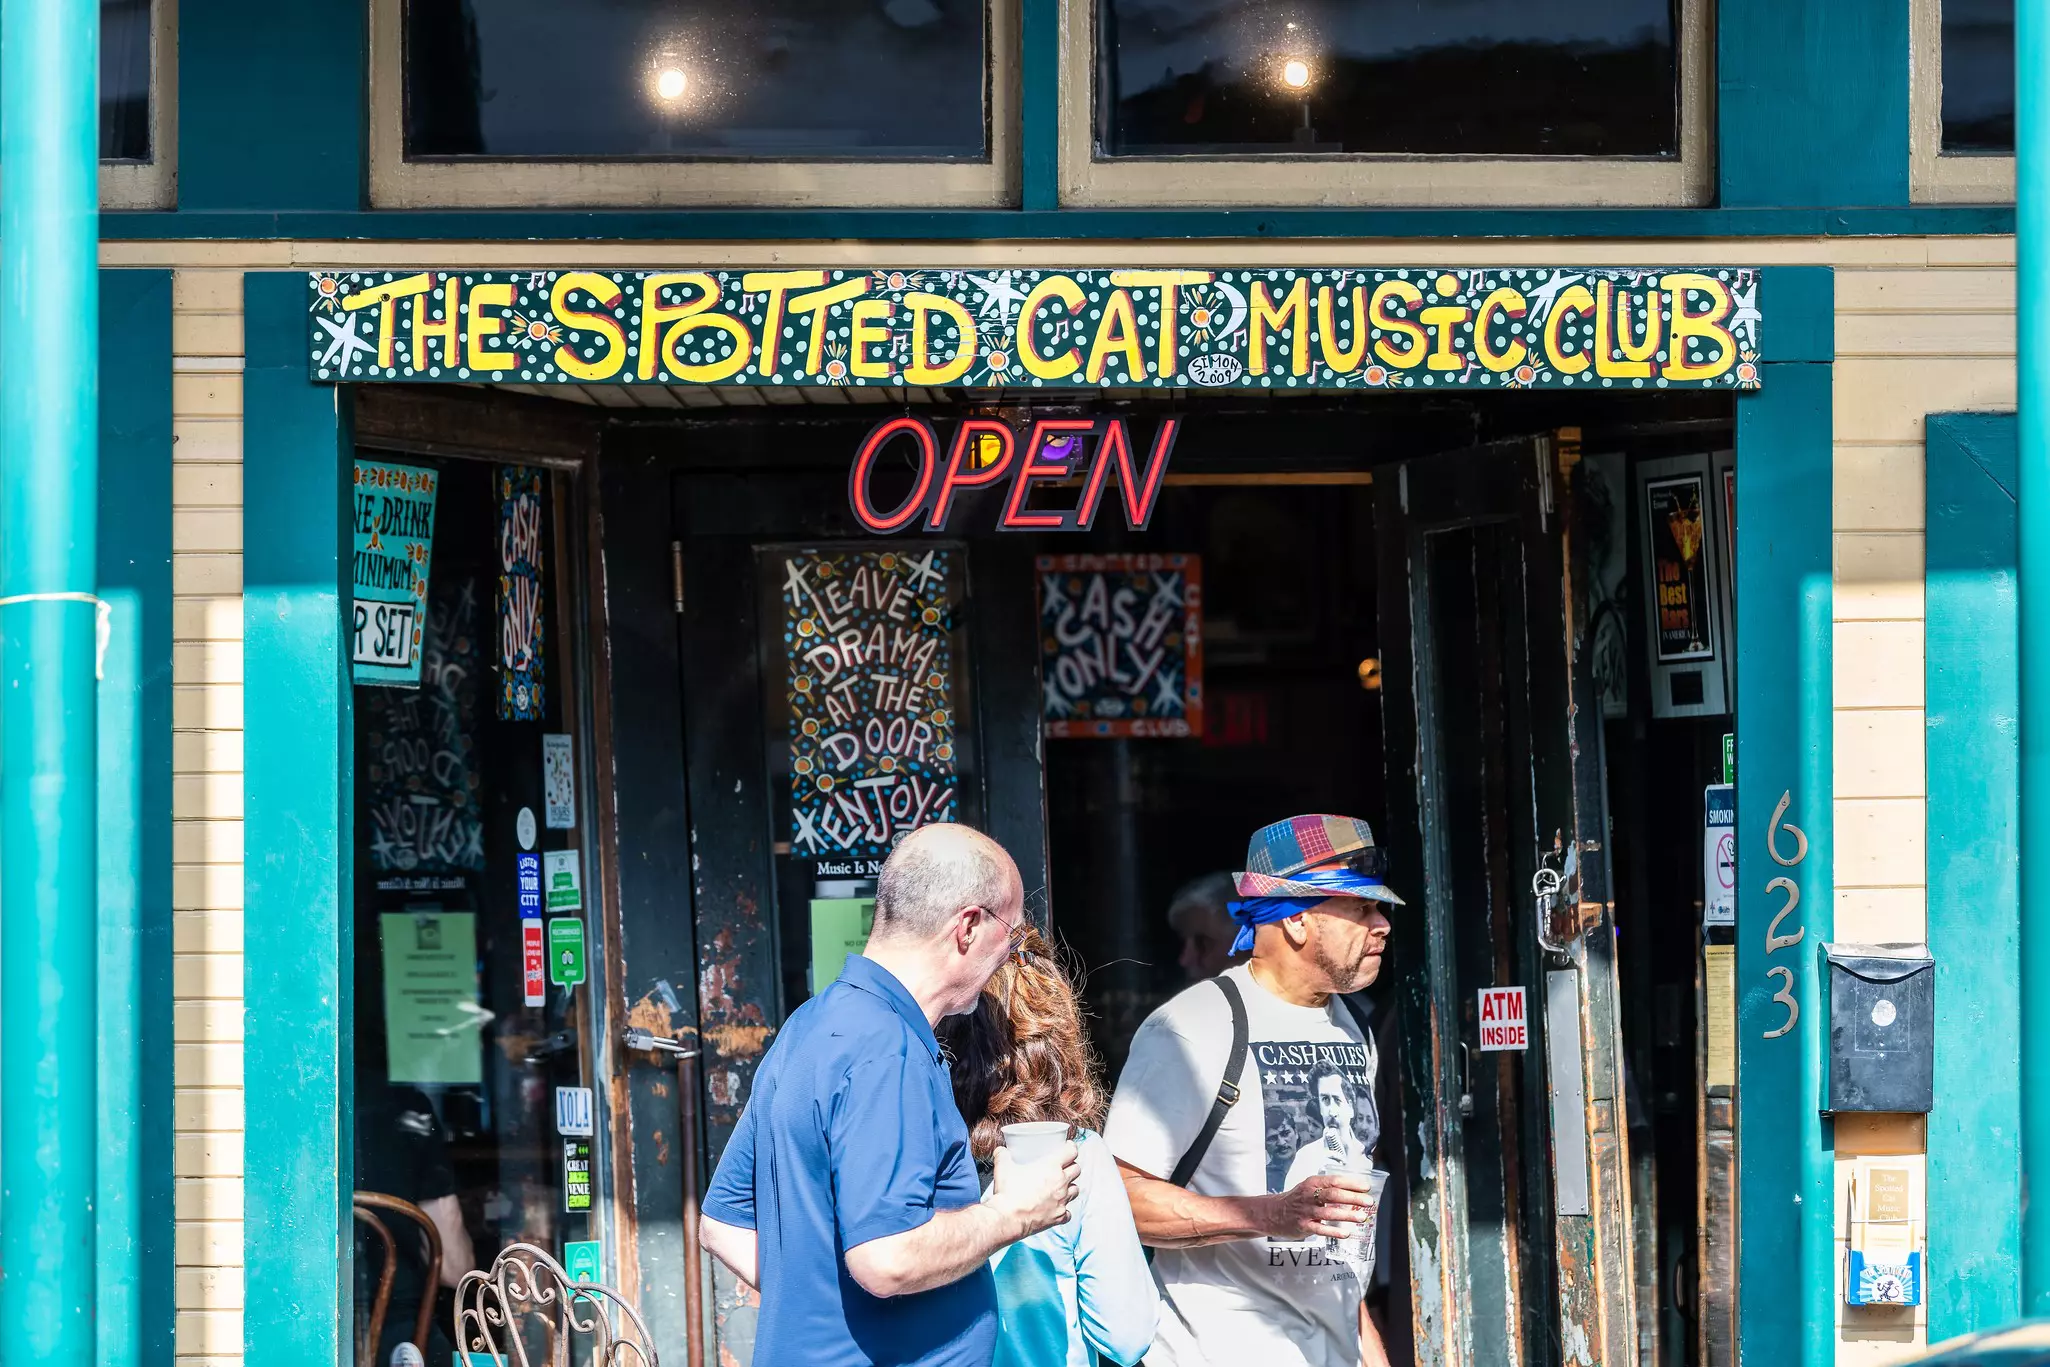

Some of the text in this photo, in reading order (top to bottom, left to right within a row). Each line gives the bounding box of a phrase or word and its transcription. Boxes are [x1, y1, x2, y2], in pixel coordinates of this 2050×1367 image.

[342, 270, 1738, 384] THE SPOTTED CAT MUSIC CLUB
[1192, 355, 1239, 373] SIMON
[1197, 370, 1232, 384] 2009
[852, 416, 1176, 529] OPEN
[354, 493, 433, 539] NE DRINK
[502, 494, 540, 573] CASH
[811, 565, 915, 633] LEAVE
[1659, 583, 1687, 606] Best
[503, 576, 540, 672] ONLY
[1055, 573, 1174, 650] CASH
[374, 604, 412, 659] SET
[803, 622, 938, 685] DRAMA
[1055, 632, 1165, 697] ONLY
[824, 673, 925, 727] AT THE
[1708, 809, 1734, 824] SMOKIN
[519, 857, 538, 870] LISTEN
[817, 860, 883, 875] Music Is No
[520, 877, 538, 891] YOUR
[520, 893, 539, 906] CITY
[1481, 991, 1523, 1021] ATM
[1482, 1026, 1525, 1046] INSIDE
[1258, 1043, 1366, 1067] CASH RULES
[559, 1090, 590, 1128] NOLA
[566, 1159, 589, 1172] GREAT
[568, 1183, 591, 1195] VENUE
